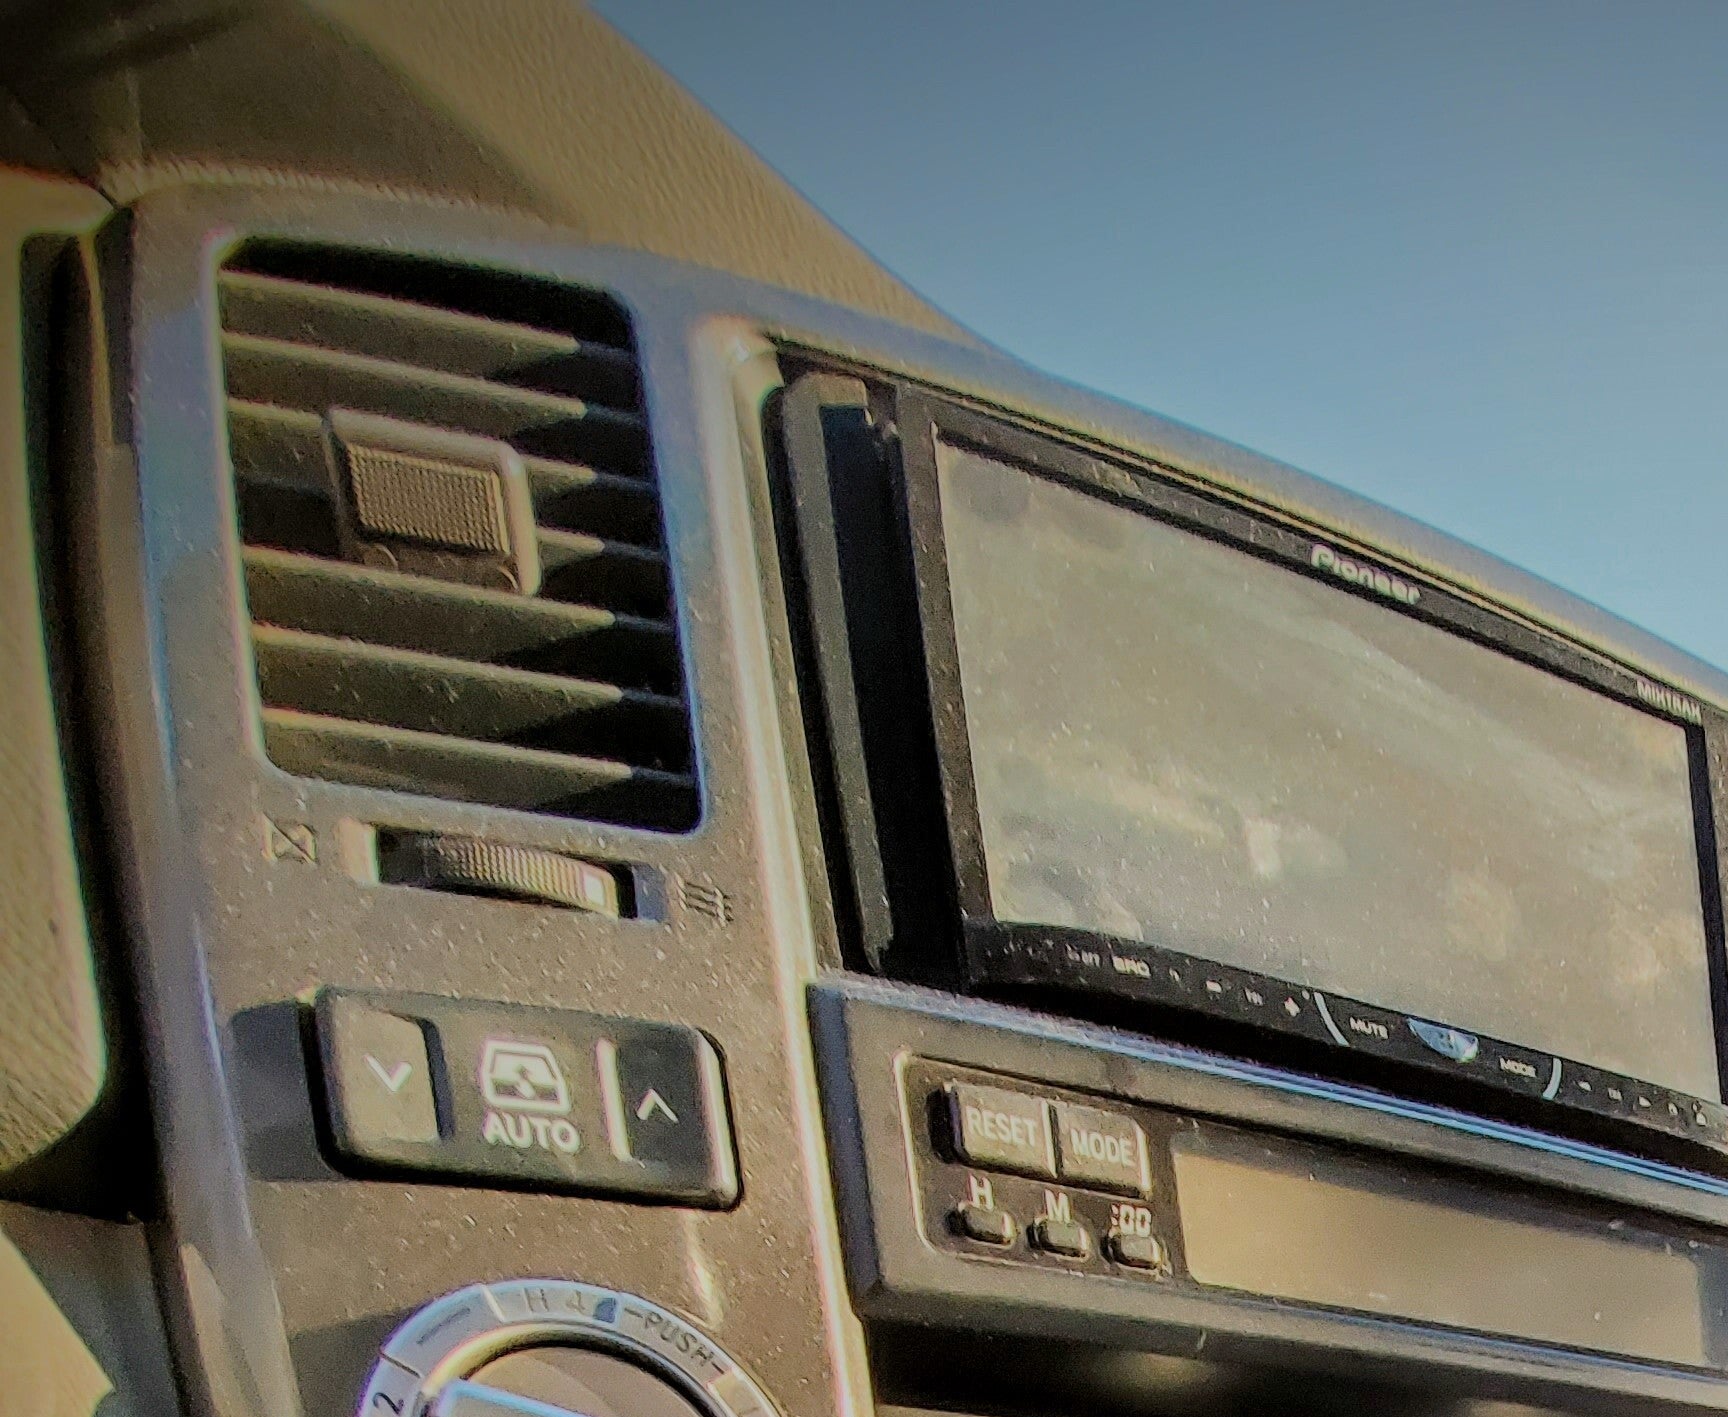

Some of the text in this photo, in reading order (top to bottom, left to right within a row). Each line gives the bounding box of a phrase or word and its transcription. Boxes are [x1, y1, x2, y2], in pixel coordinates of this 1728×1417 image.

[1310, 543, 1421, 605] Pioneer
[1346, 1016, 1389, 1040] MUTE
[481, 1110, 581, 1154] AUTO
[964, 1109, 1040, 1149] RESET
[1069, 1126, 1137, 1169] MODE
[968, 1175, 994, 1210] H
[1043, 1191, 1071, 1222] M
